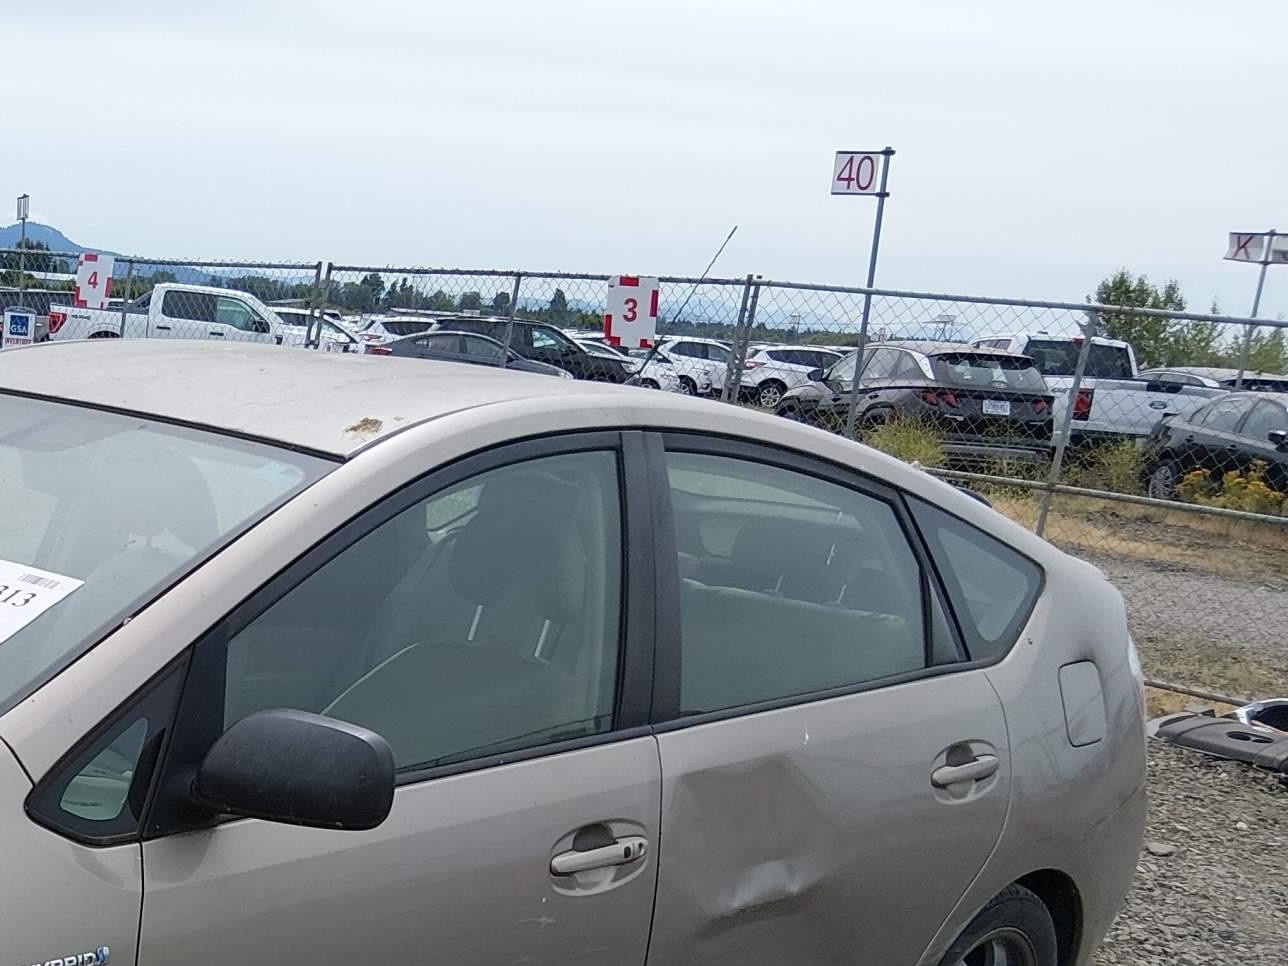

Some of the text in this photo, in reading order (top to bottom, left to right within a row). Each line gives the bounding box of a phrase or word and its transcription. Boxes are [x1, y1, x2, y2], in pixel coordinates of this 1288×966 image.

[836, 155, 875, 191] 40
[1232, 235, 1255, 260] K
[87, 271, 99, 289] 4
[622, 297, 638, 323] 3
[10, 325, 28, 333] GSA
